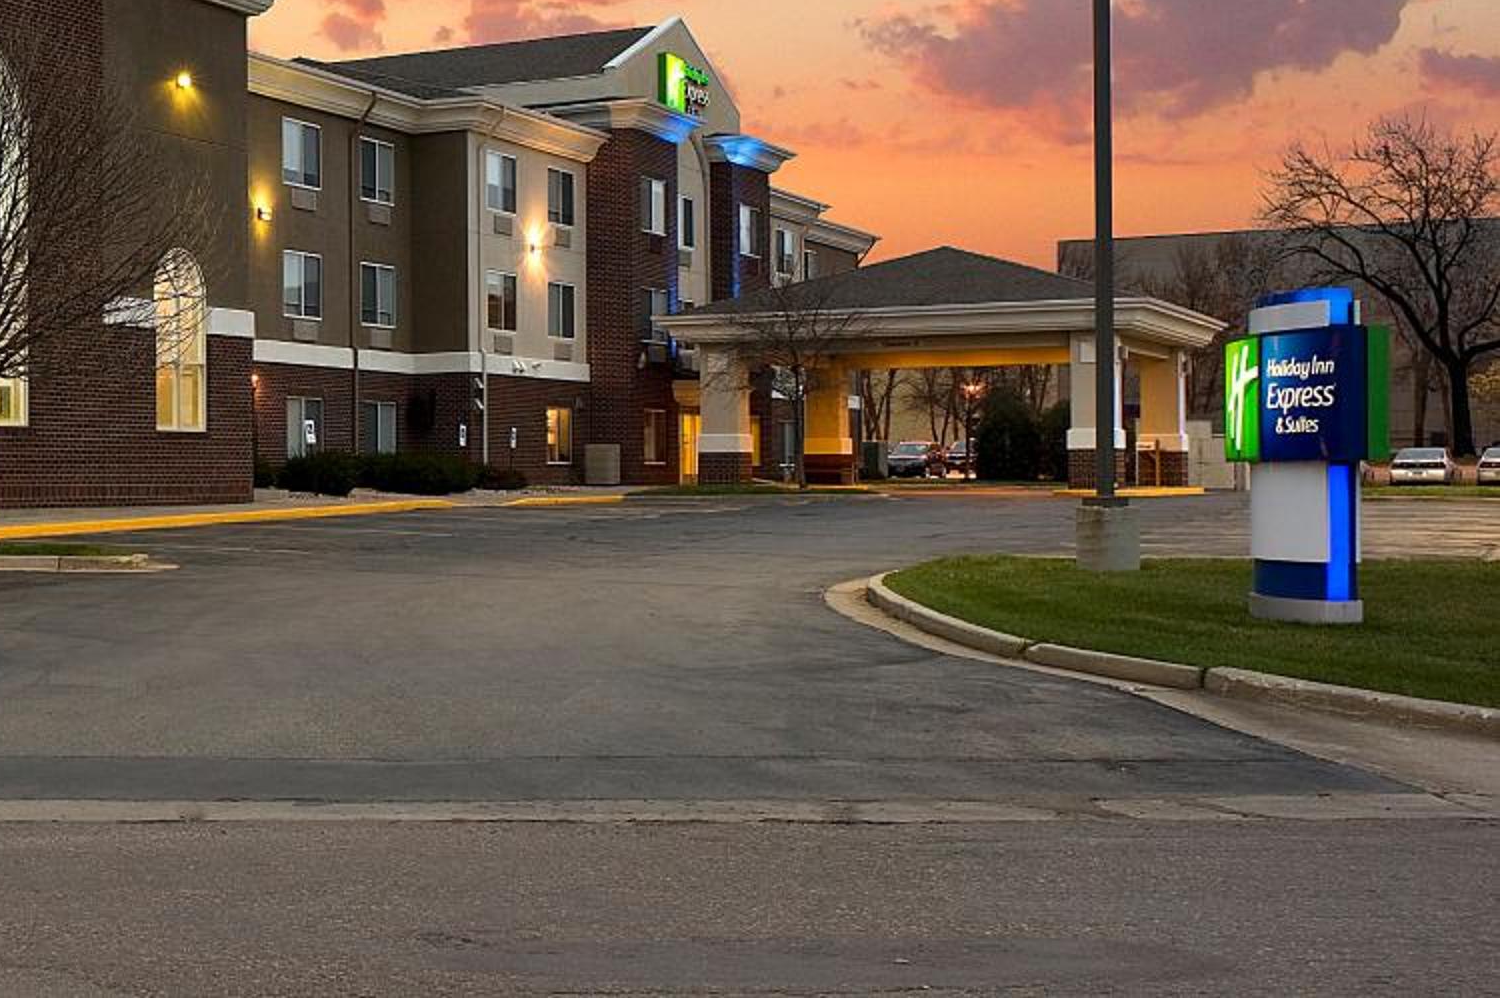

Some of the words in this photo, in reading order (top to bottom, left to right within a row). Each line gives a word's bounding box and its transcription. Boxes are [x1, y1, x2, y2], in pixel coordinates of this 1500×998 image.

[1266, 356, 1311, 379] Holiday
[1311, 354, 1335, 374] Inn
[1266, 382, 1335, 415] Express
[1275, 417, 1284, 435] &
[1285, 416, 1320, 434] Suites
